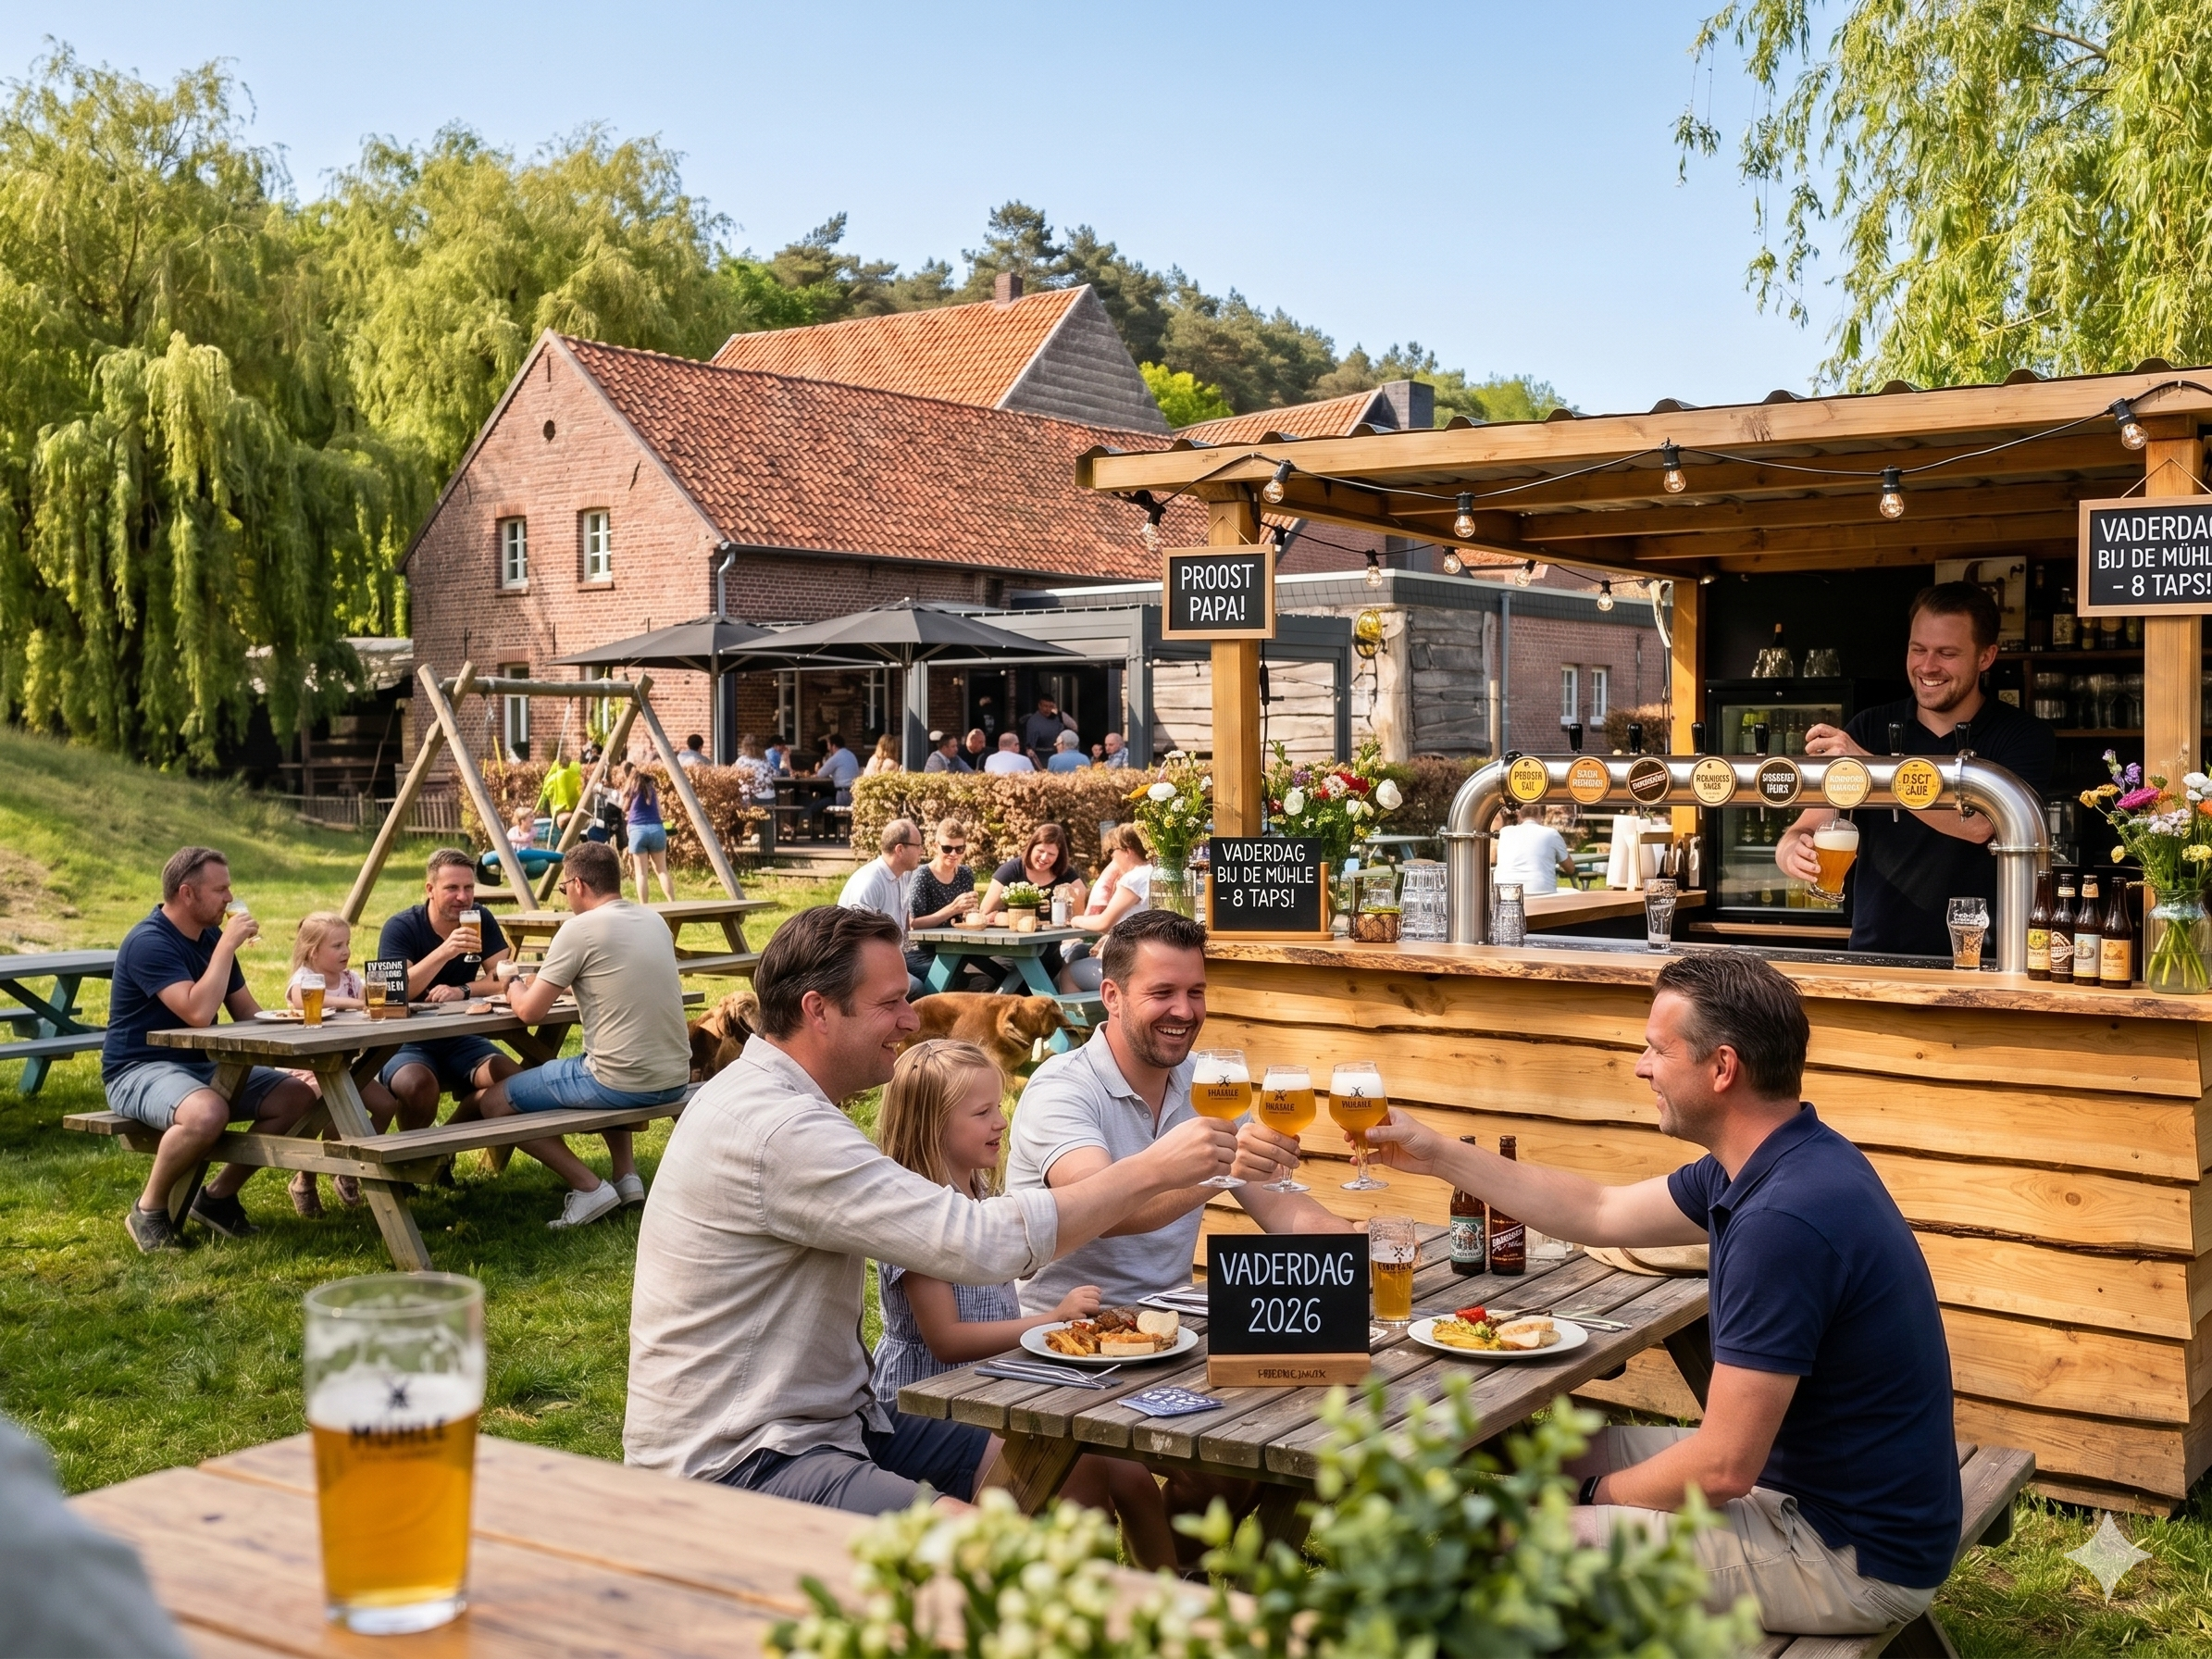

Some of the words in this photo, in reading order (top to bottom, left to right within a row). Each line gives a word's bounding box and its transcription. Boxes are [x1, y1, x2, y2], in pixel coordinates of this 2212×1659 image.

[2100, 515, 2212, 543] VADERDA
[2098, 549, 2125, 569] BIJ
[2131, 548, 2156, 568] DE
[1181, 563, 1255, 591] PROOST
[2131, 574, 2145, 597] 8
[2151, 572, 2212, 596] TAPS!
[1189, 594, 1246, 622] PAPA!
[1222, 842, 1306, 863] VADERDAG
[1217, 866, 1237, 884] BIJ
[1243, 866, 1261, 883] DE
[1265, 864, 1314, 884] MÜHLE
[1232, 888, 1244, 907] 8
[1249, 888, 1296, 908] TAPS!
[1219, 1252, 1354, 1286] VADERDAG
[1248, 1297, 1321, 1333] 2026
